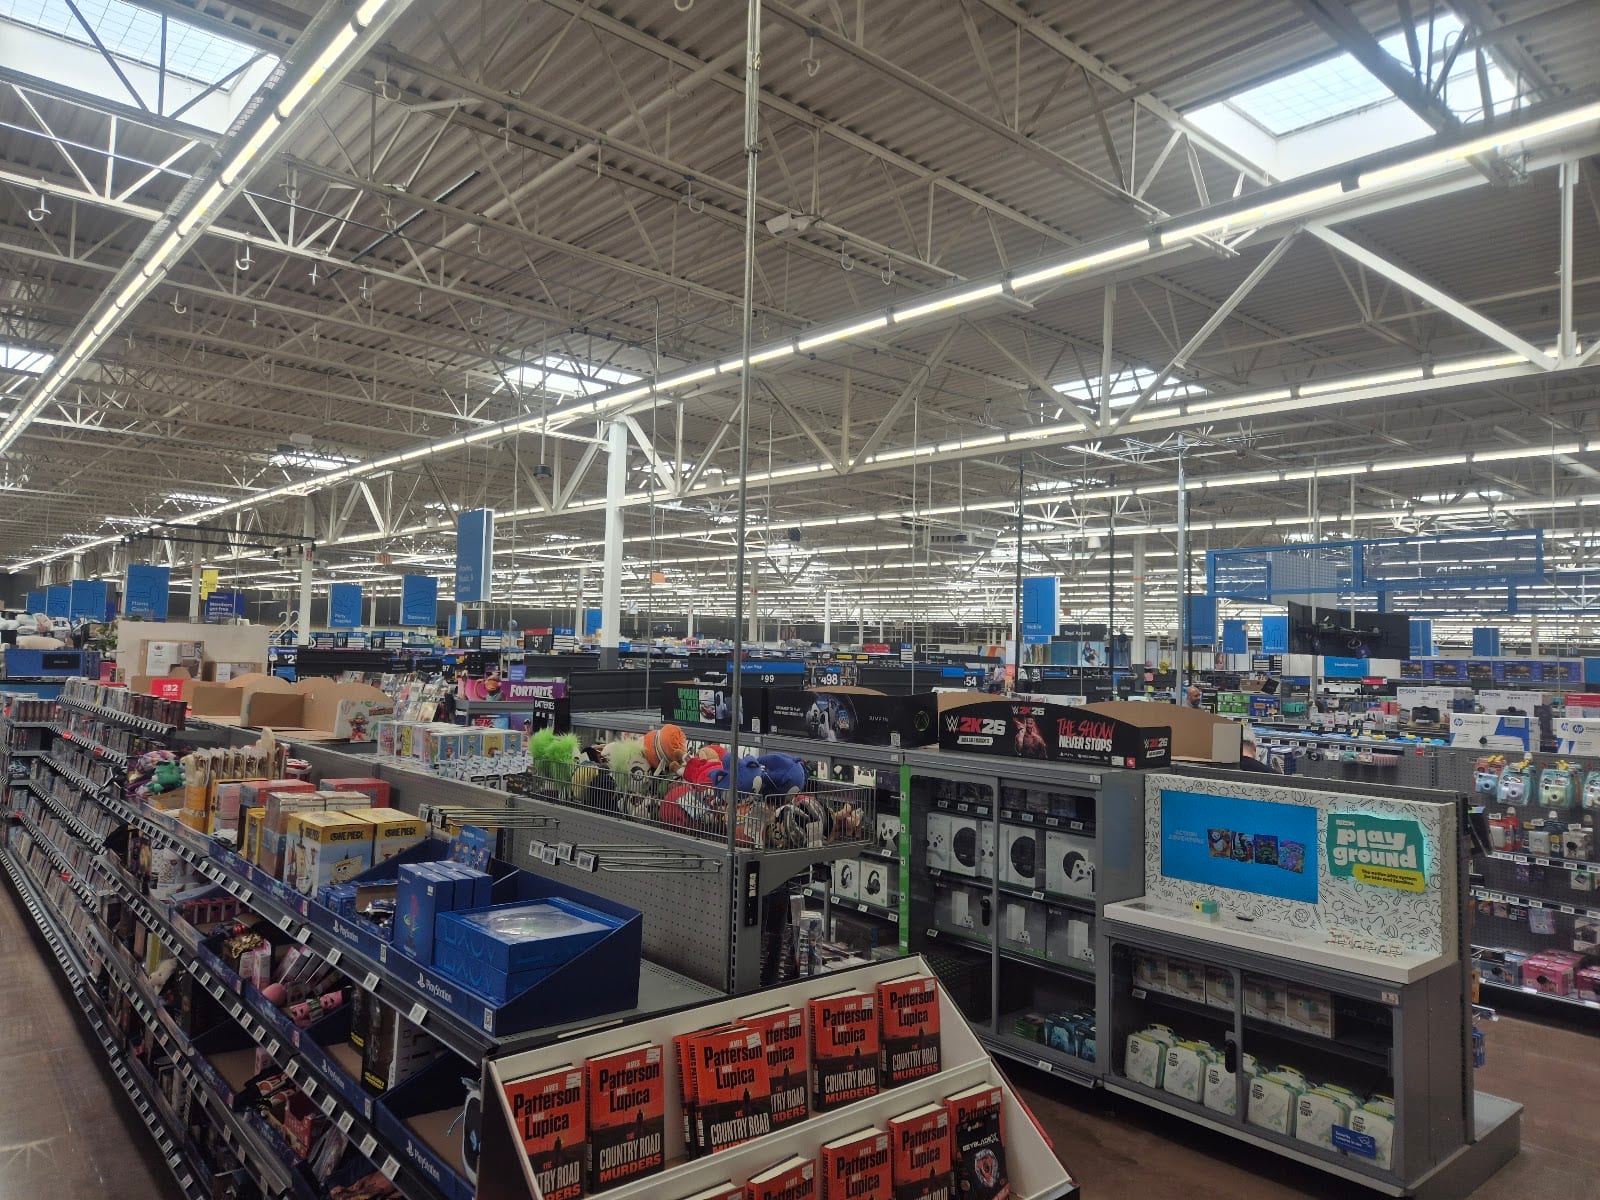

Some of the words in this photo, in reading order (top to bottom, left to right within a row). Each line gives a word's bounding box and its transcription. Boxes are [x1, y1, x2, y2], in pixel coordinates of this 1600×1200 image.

[510, 684, 555, 699] FORTNITE
[535, 700, 554, 710] BATTERIES
[1019, 706, 1045, 716] 2K26
[960, 717, 1006, 736] 2K26
[1057, 718, 1077, 738] THE
[1078, 719, 1116, 740] SHOW
[1454, 718, 1463, 727] hp
[1572, 724, 1584, 734] hp
[1059, 735, 1085, 750] NEVER
[1085, 737, 1113, 752] STOPS
[330, 831, 345, 841] ONE
[346, 830, 364, 840] PIECE
[384, 829, 400, 837] ONE
[401, 827, 416, 836] PIECE
[1336, 829, 1406, 851] play
[1333, 845, 1417, 868] ground
[340, 925, 359, 942] PlayStation
[425, 979, 452, 1003] PlayStation
[889, 991, 935, 1010] Patterson
[823, 1008, 873, 1027] Patterson
[899, 1009, 929, 1028] Lupica
[766, 1025, 801, 1045] tterson
[831, 1027, 866, 1046] Lupica
[704, 1045, 762, 1068] Patterson
[767, 1046, 794, 1066] upica
[892, 1050, 921, 1072] COUNTRY
[922, 1046, 938, 1064] ROAD
[600, 1062, 660, 1092] Patterson
[716, 1067, 755, 1089] Lupica
[825, 1071, 857, 1093] COUNTRY
[859, 1067, 875, 1085] ROAD
[893, 1064, 939, 1080] MURDERS
[514, 1087, 580, 1118] Patterson
[610, 1088, 650, 1113] Lupica
[787, 1086, 805, 1105] ROAD
[825, 1085, 877, 1104] MURDERS
[772, 1105, 806, 1121] RDERS
[525, 1113, 570, 1140] Lupica
[711, 1116, 748, 1145] COUNTRY
[748, 1112, 770, 1137] ROAD
[902, 1125, 947, 1152] Patterson
[600, 1138, 639, 1170] COUNTRY
[639, 1133, 661, 1159] ROAD
[910, 1146, 941, 1170] Lupica
[414, 1148, 440, 1182] PlayStation
[557, 1160, 580, 1189] ROAD
[600, 1154, 662, 1183] MURDERS
[837, 1149, 888, 1179] Patterson
[544, 1184, 580, 1200] DERS
[845, 1174, 880, 1199] Lupica
